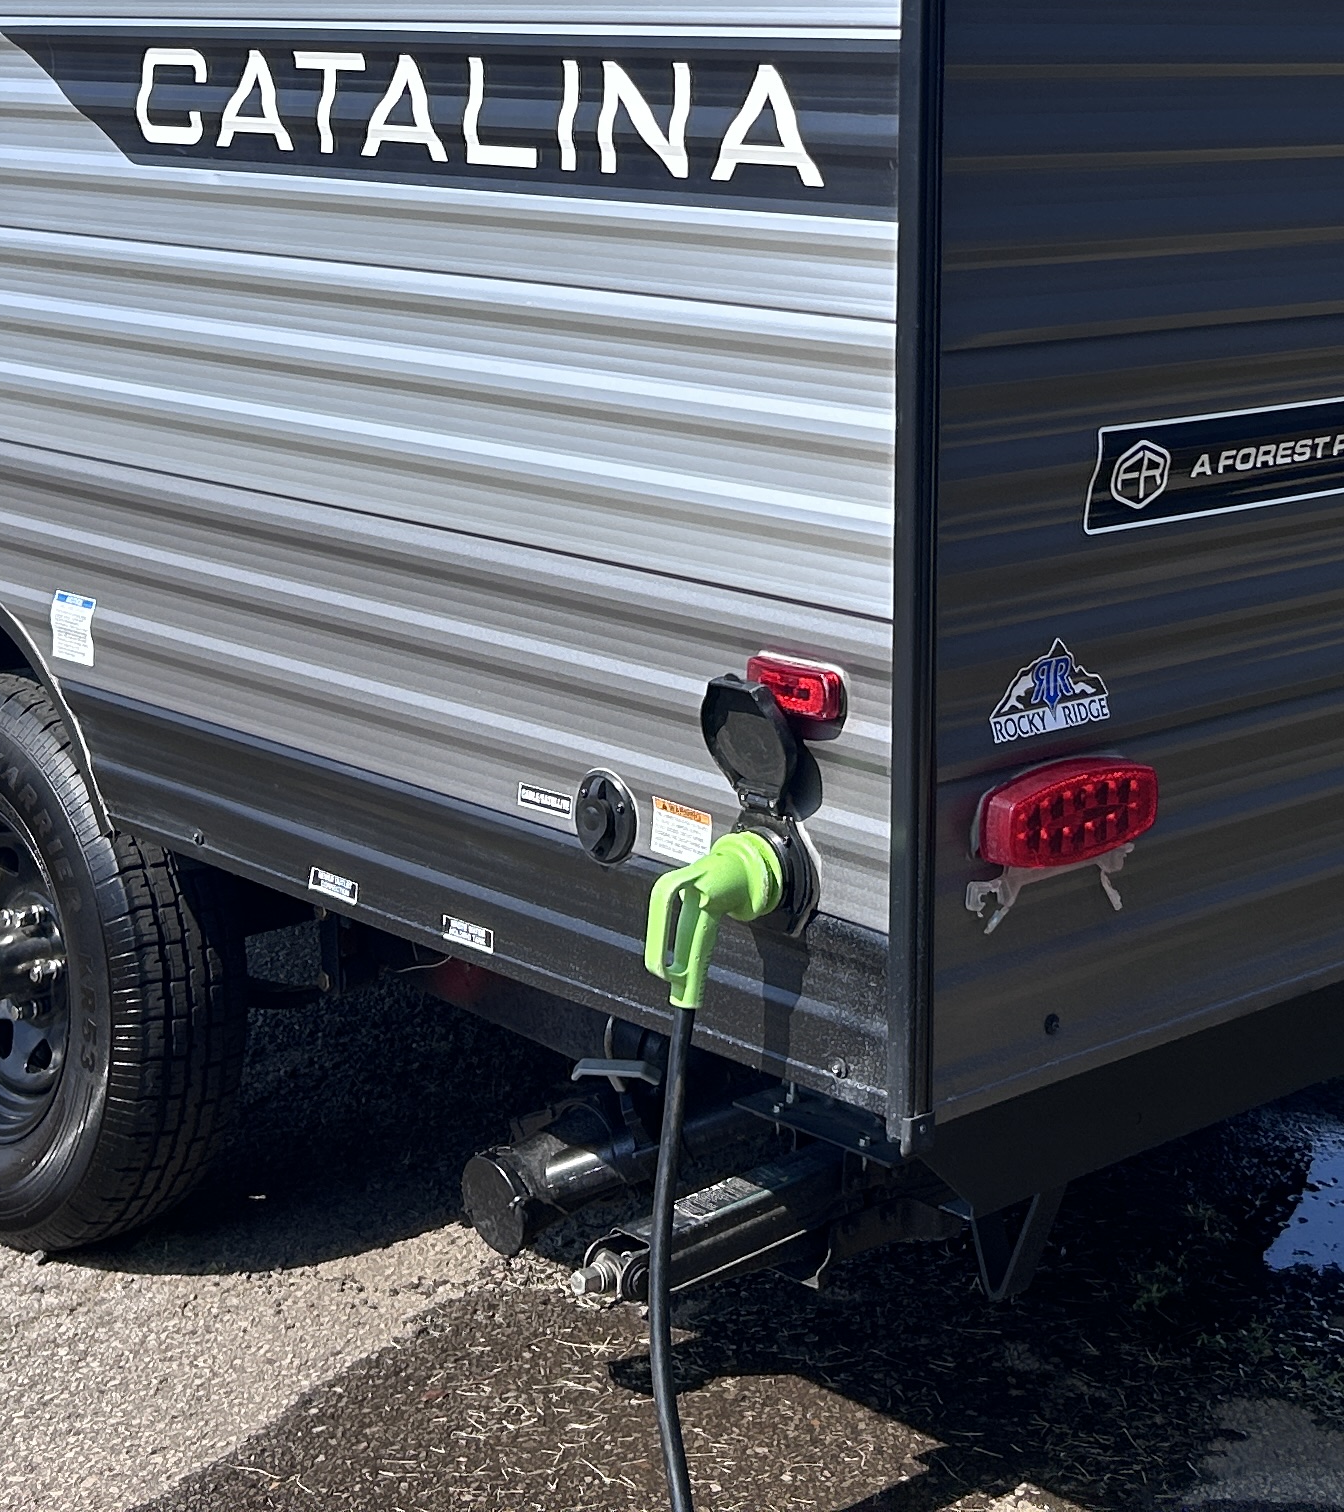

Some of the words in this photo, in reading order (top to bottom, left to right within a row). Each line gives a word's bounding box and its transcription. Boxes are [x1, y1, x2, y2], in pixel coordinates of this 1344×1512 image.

[135, 48, 825, 188] CATALINA
[1189, 454, 1213, 478] A
[1217, 435, 1330, 475] FOREST
[994, 710, 1048, 741] ROCKY
[1063, 697, 1108, 725] RIDGE
[75, 950, 98, 1075] KR53
